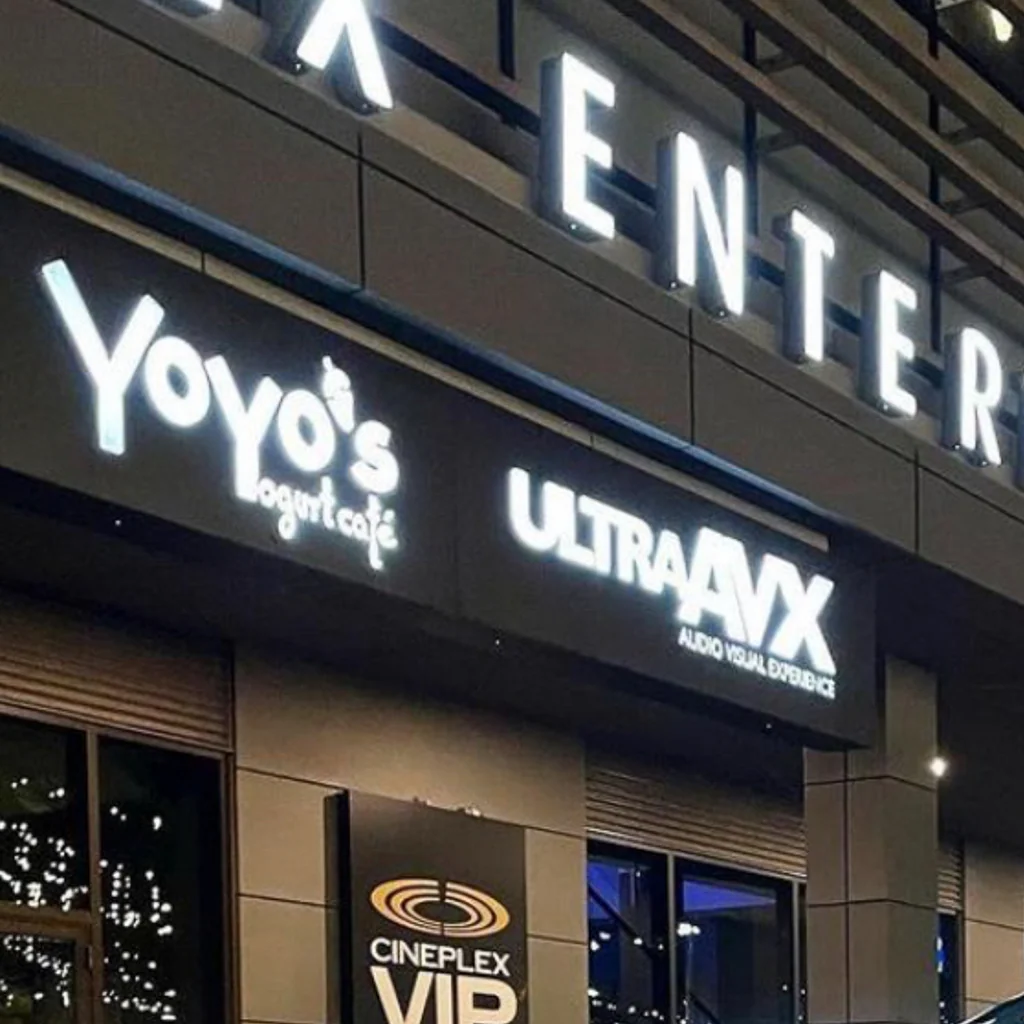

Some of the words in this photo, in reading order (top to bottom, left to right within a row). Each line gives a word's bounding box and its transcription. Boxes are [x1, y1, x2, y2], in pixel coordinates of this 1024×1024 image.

[677, 625, 724, 662] AUDIO
[724, 642, 769, 677] VISUAL
[370, 937, 510, 977] CINEPLEX
